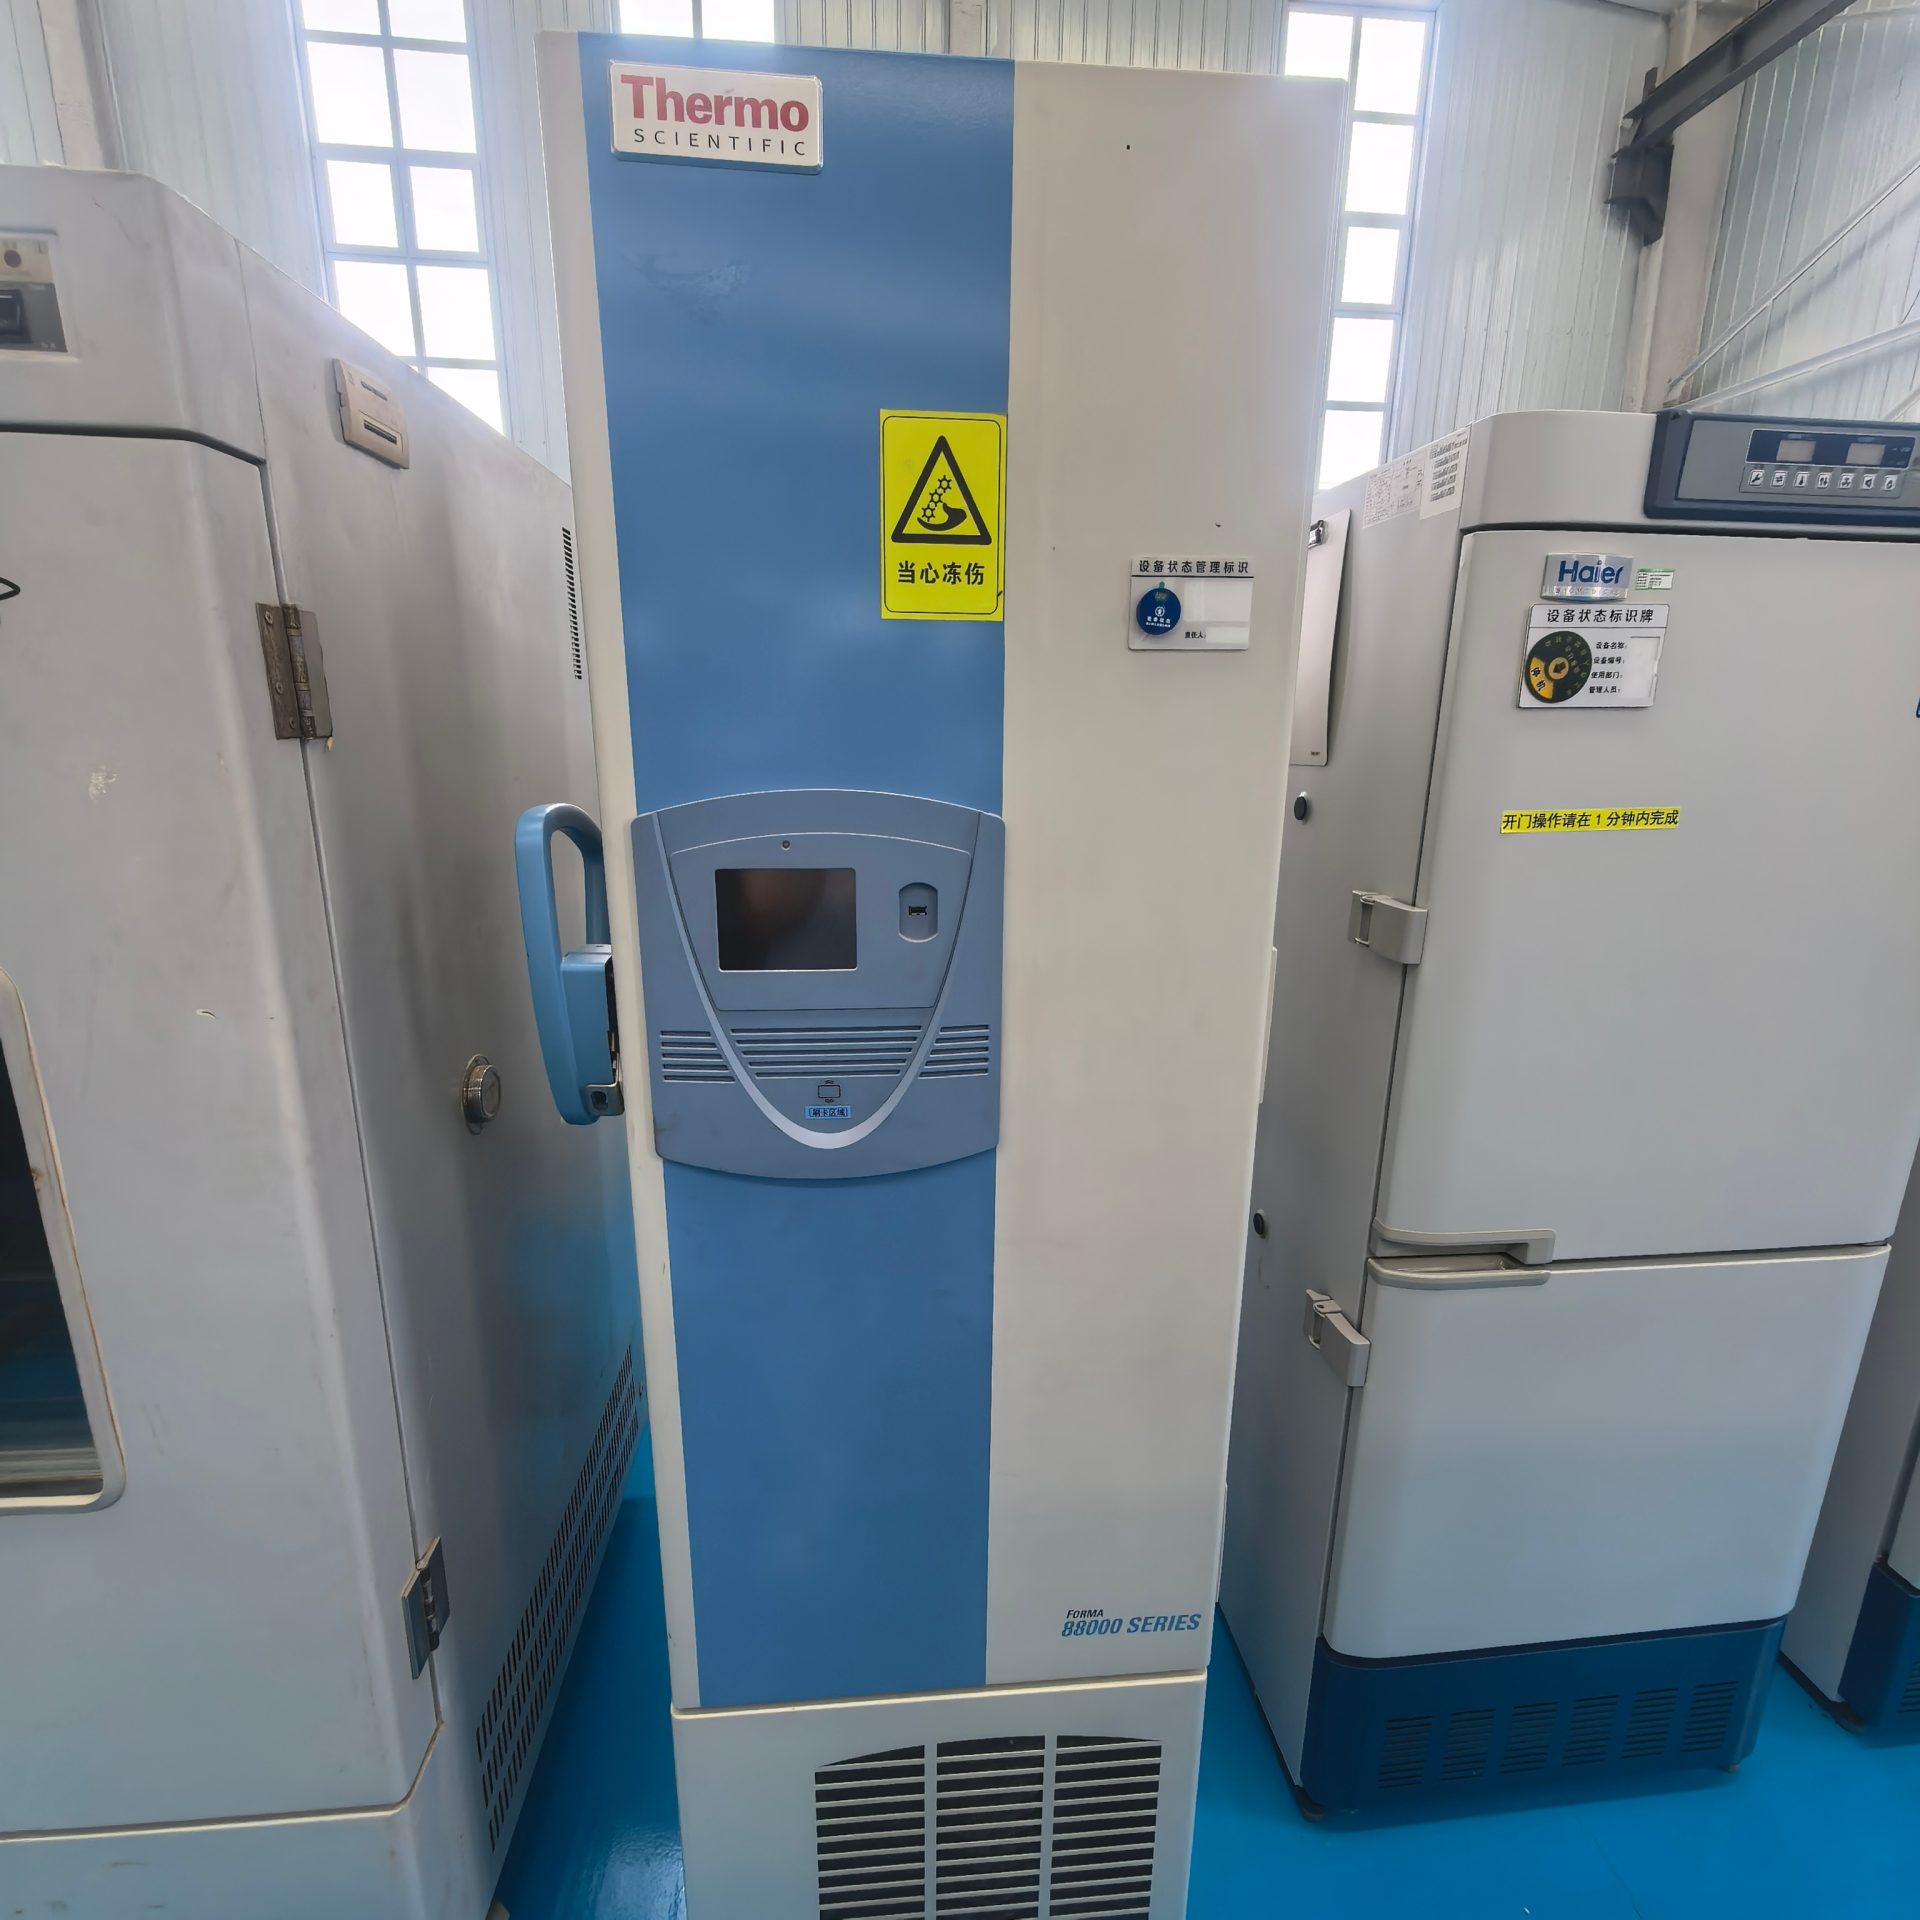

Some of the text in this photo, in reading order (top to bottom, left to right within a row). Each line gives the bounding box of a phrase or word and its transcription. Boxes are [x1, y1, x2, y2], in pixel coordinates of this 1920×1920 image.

[621, 74, 809, 132] Thermo
[634, 128, 806, 156] SCIENTIFIC
[897, 560, 985, 585] 当心冻伤
[1139, 560, 1249, 574] 设备状态管理标识
[1558, 560, 1625, 584] Haier
[1546, 608, 1654, 623] 设备状态标识牌
[1061, 1614, 1201, 1637] 88000 SERIES
